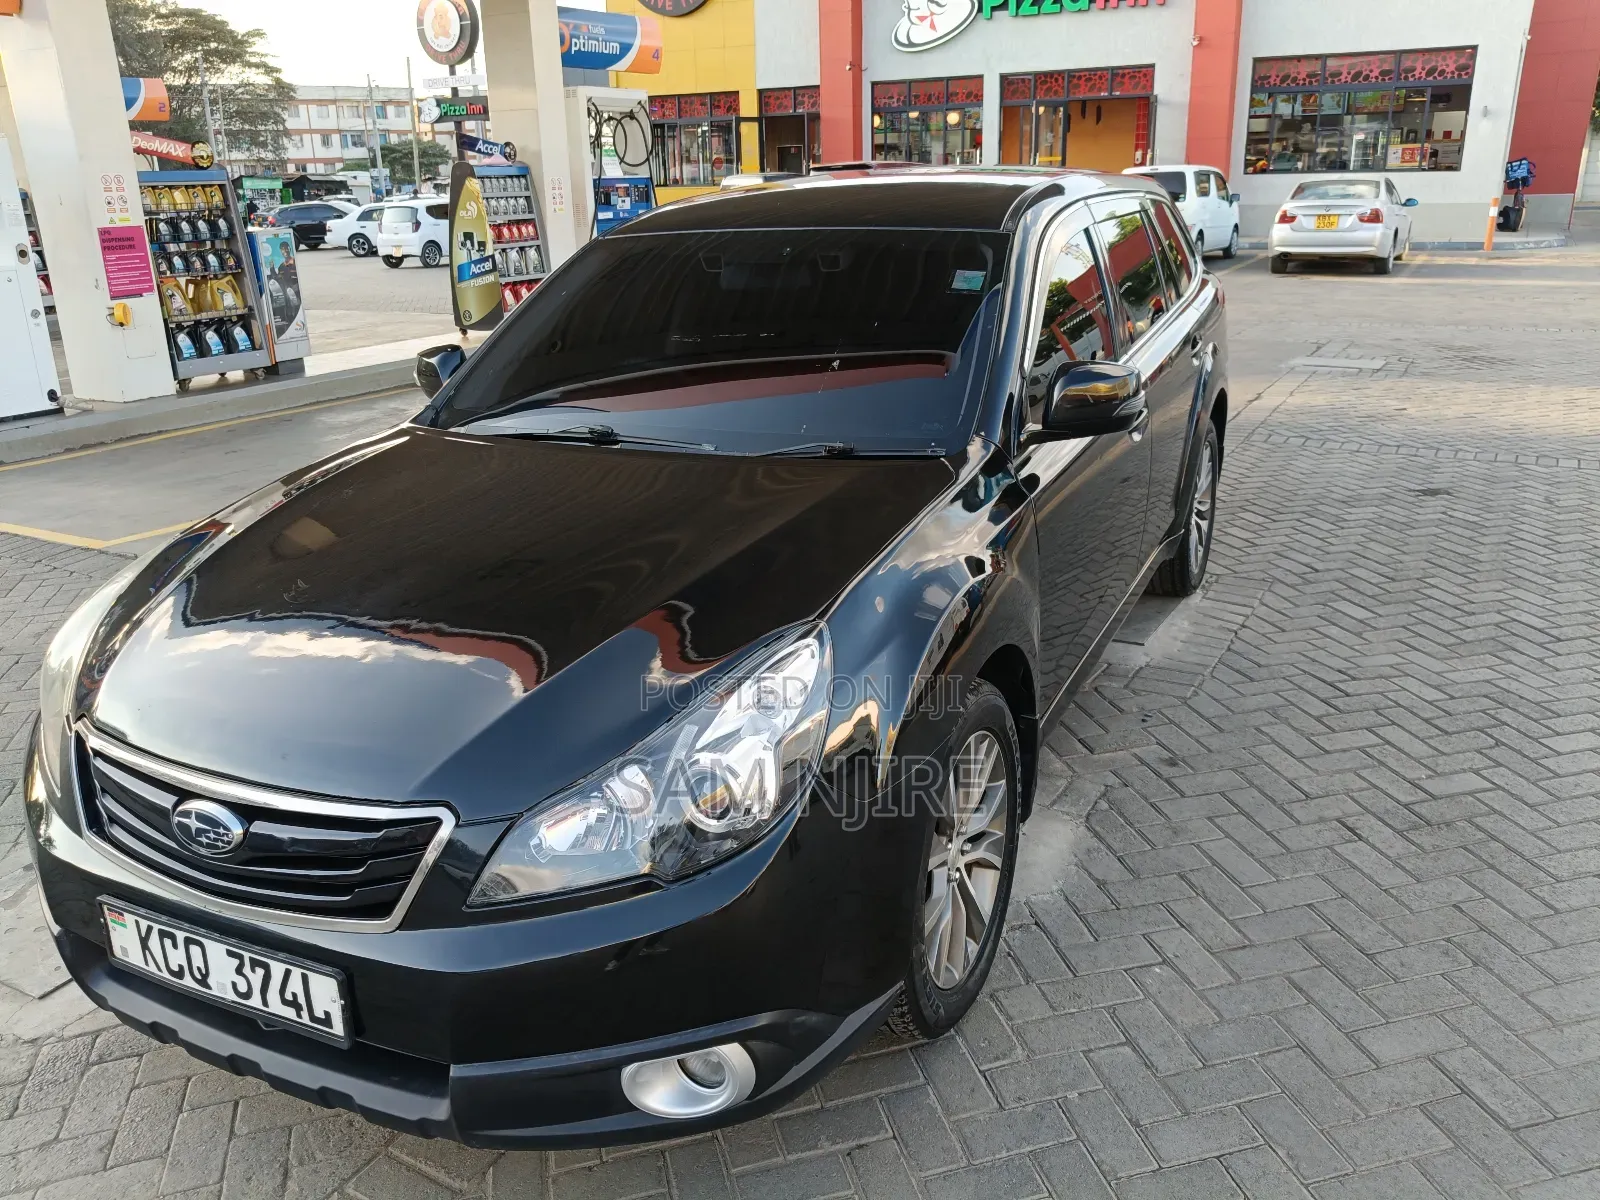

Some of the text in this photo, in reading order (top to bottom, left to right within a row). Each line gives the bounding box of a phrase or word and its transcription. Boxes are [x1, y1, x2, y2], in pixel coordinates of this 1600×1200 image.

[652, 48, 660, 61] 4
[428, 76, 471, 88] DRIVE THRU
[158, 102, 166, 112] 2
[132, 136, 186, 158] DeoMAX
[475, 139, 501, 155] Accel
[470, 258, 492, 276] Accel
[470, 274, 495, 288] FUSION
[135, 919, 212, 990] KCQ
[225, 948, 333, 1030] 374L
